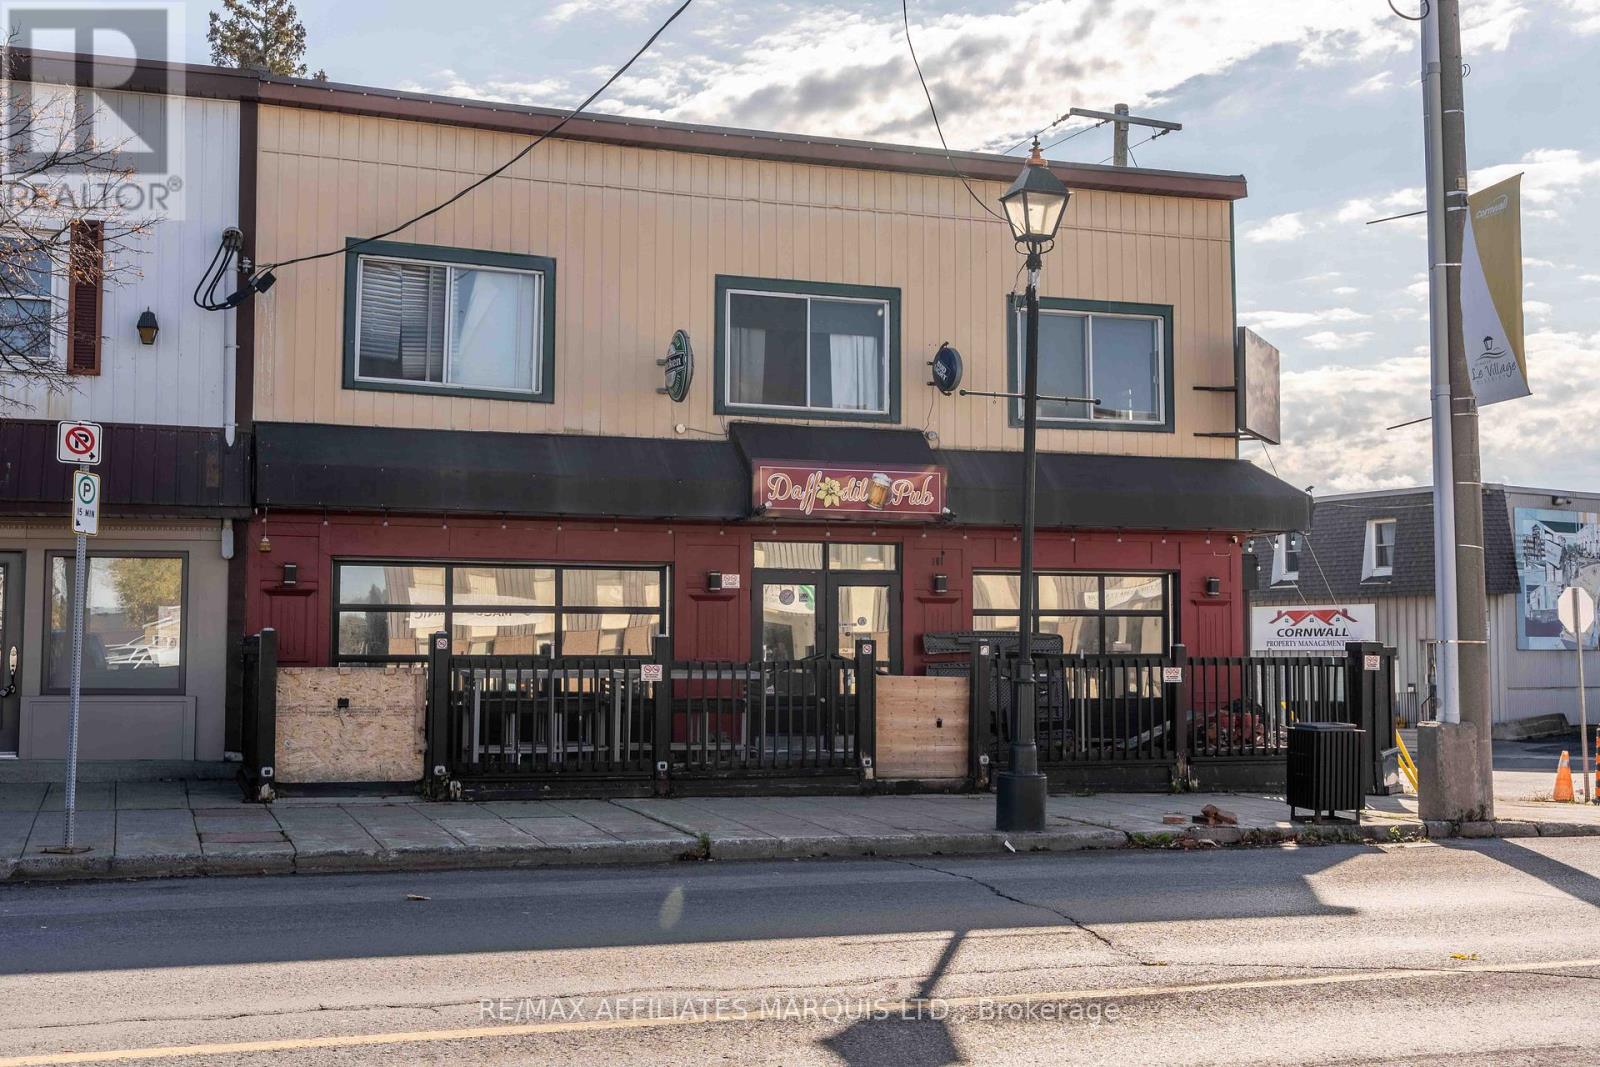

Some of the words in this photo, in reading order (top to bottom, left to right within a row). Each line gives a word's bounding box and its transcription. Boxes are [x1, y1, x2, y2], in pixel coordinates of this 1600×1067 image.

[1485, 361, 1517, 378] Village
[891, 476, 935, 506] Pub
[85, 509, 95, 518] MIN
[1277, 628, 1349, 638] CORNWALL
[1266, 640, 1297, 648] PROPERTY
[1298, 640, 1345, 648] MANAGEMENT
